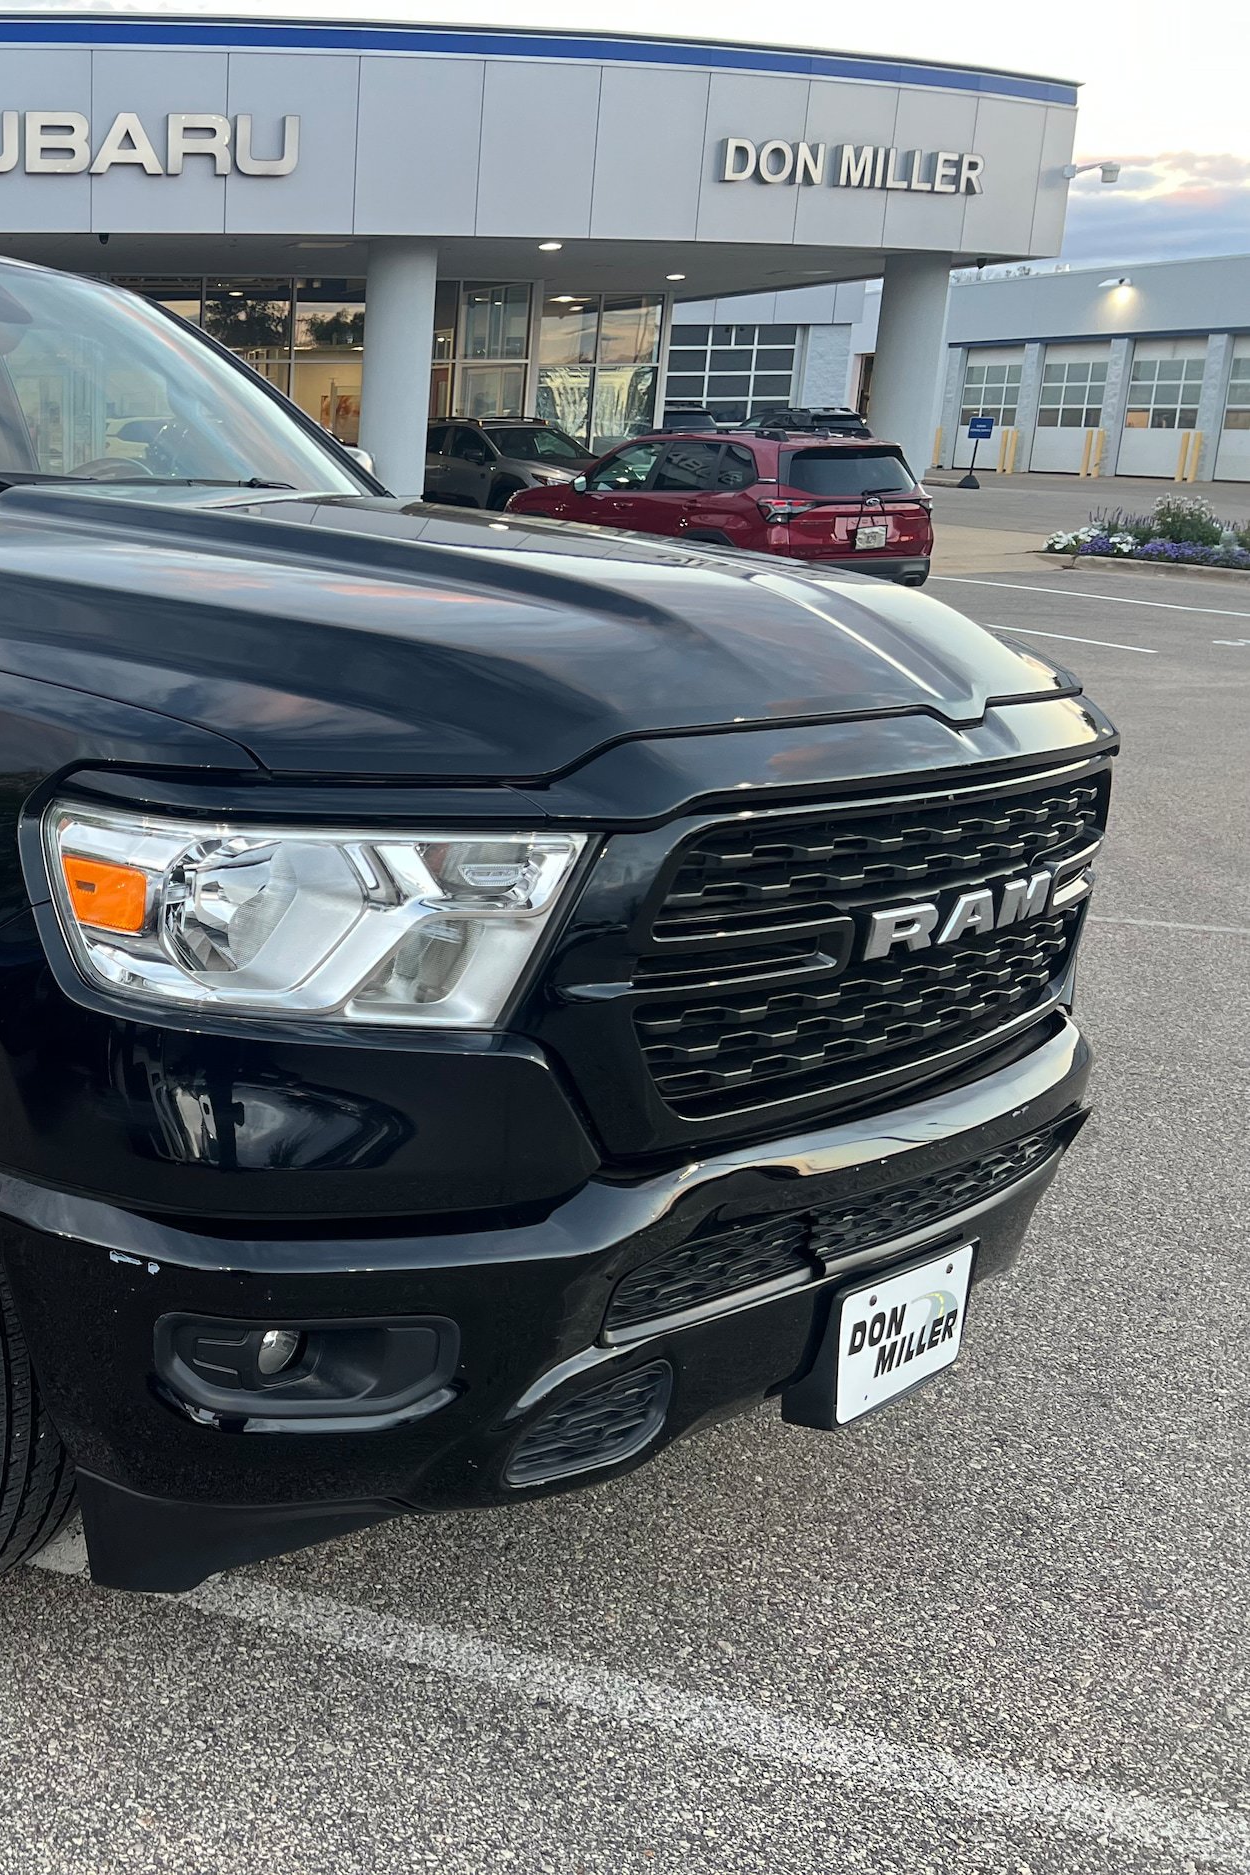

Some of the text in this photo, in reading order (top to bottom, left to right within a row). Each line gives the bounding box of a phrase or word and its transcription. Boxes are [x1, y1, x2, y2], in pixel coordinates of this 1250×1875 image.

[720, 137, 985, 195] DON MILLER
[863, 868, 1052, 962] RAM
[847, 1303, 907, 1356] DON
[873, 1308, 958, 1379] MILLER
